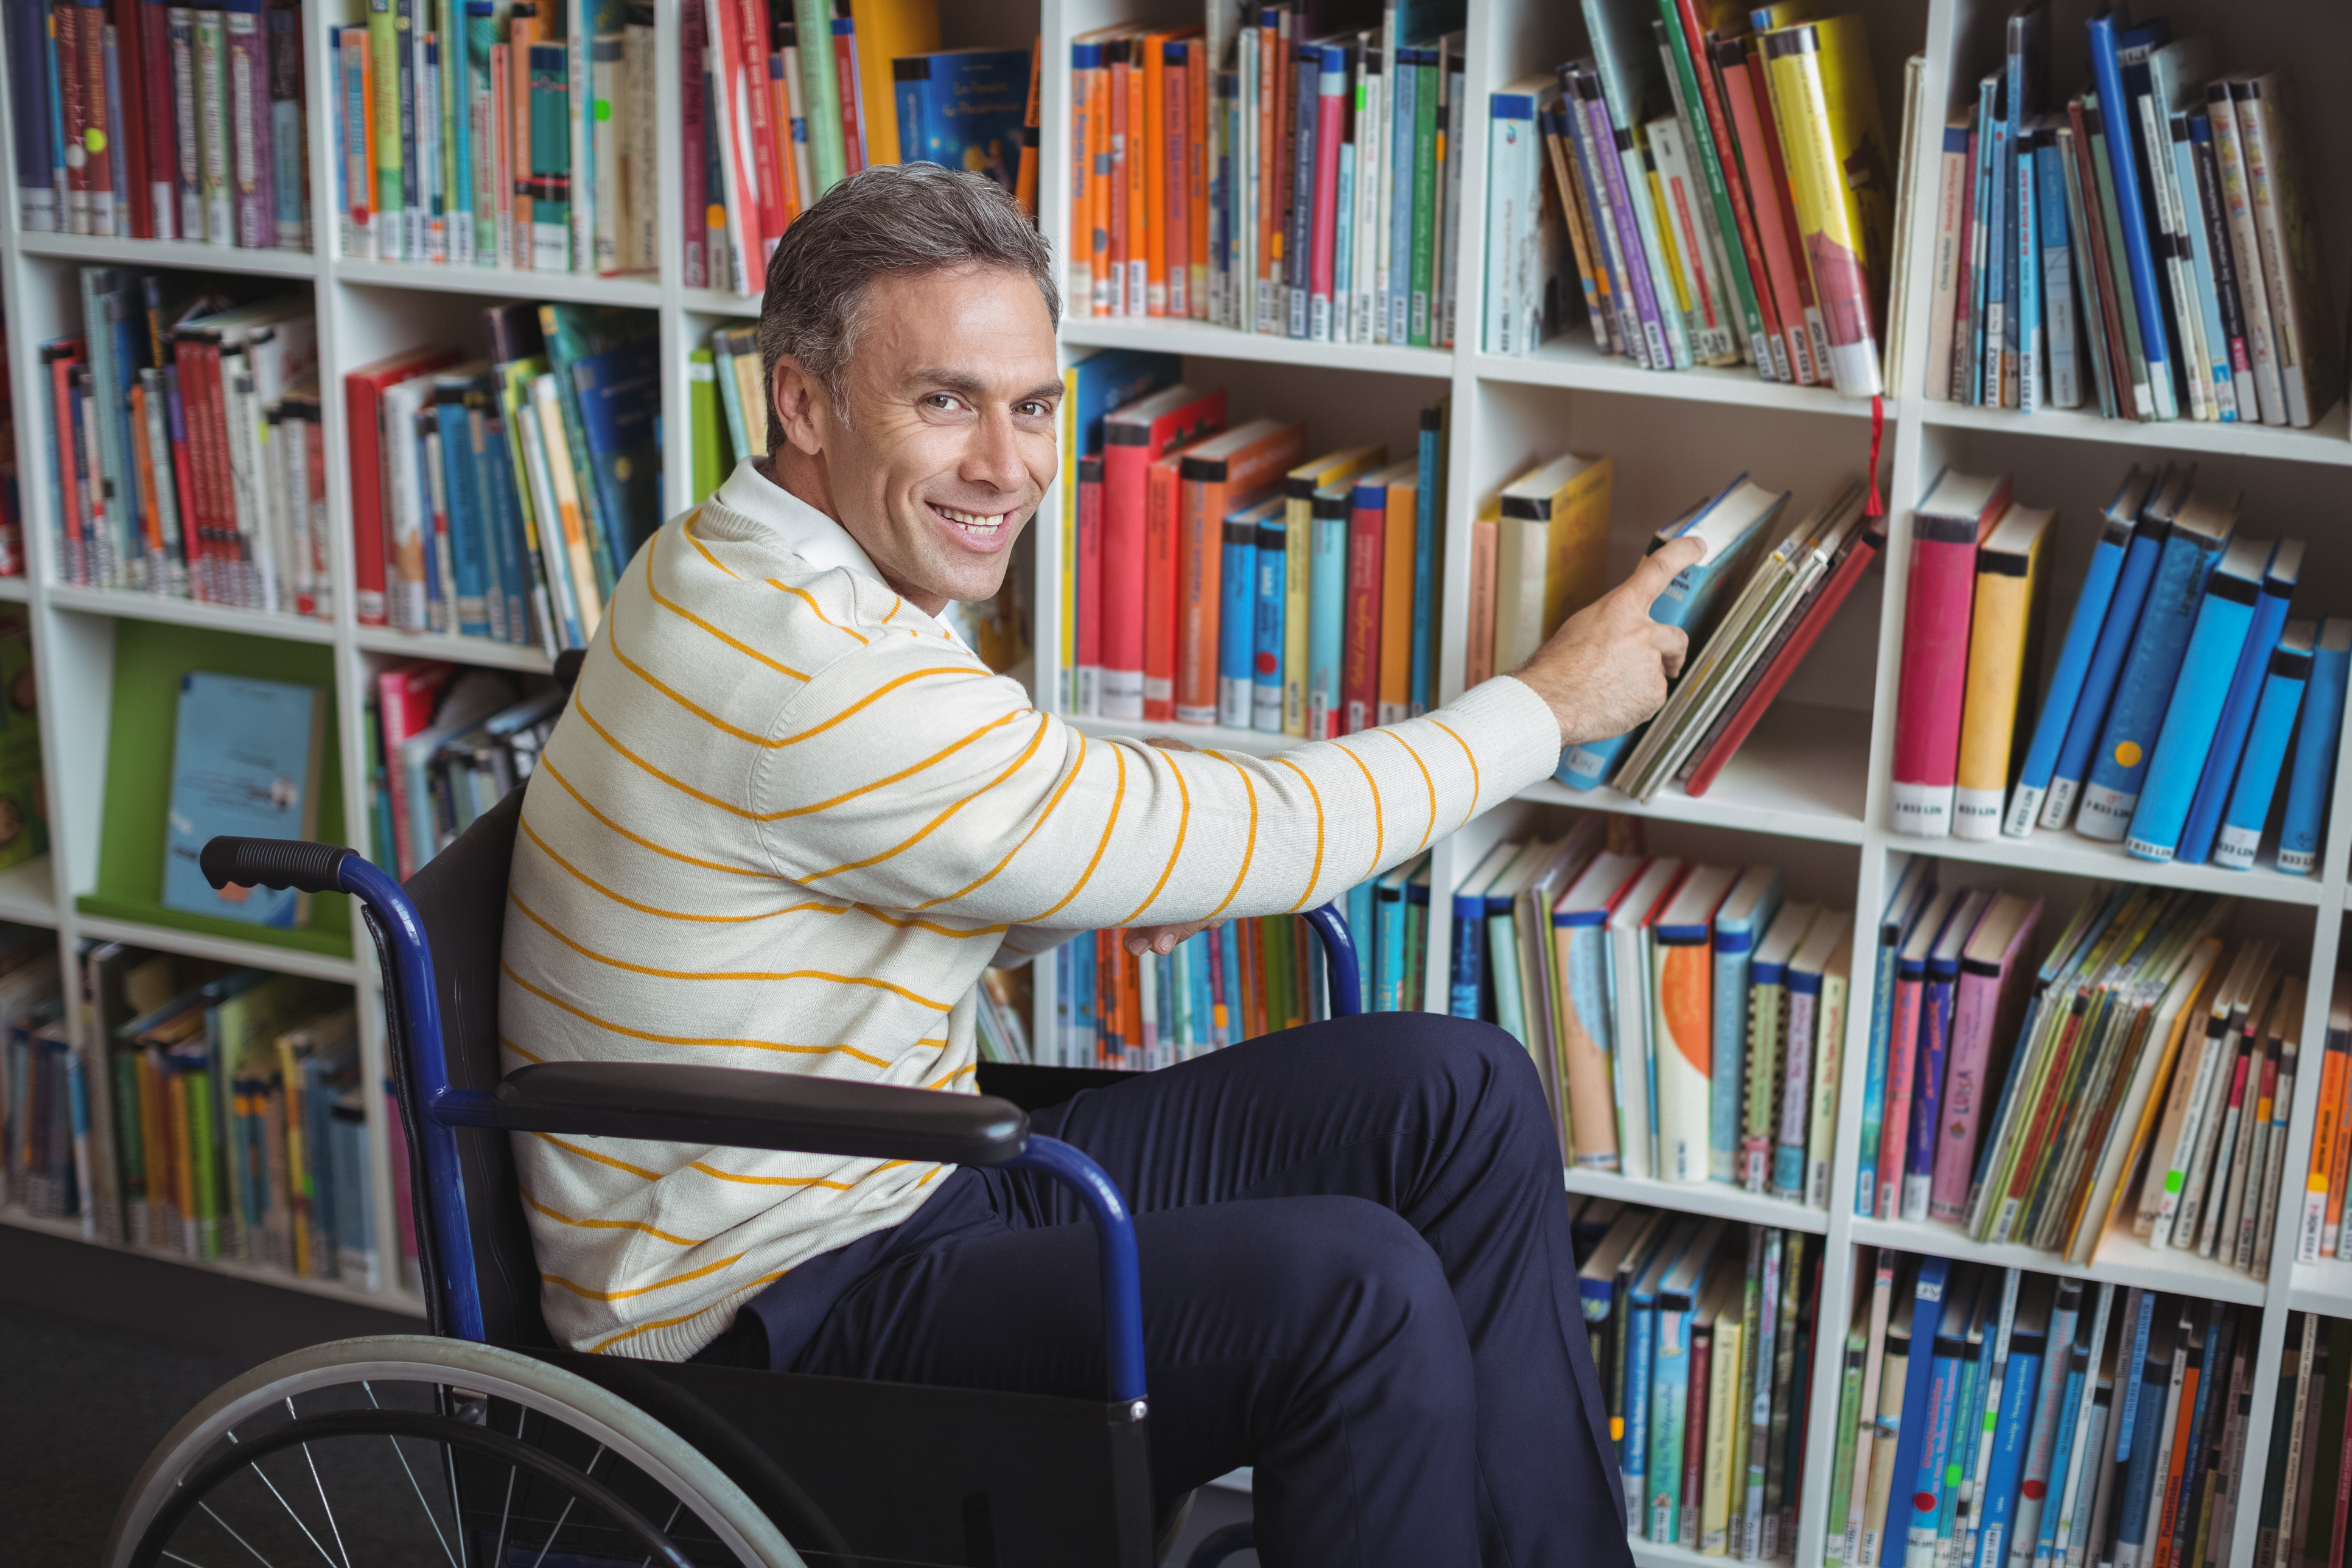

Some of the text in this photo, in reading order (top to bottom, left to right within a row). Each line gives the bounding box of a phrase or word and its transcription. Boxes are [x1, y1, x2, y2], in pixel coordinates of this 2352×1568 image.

[2022, 190, 2029, 203] um
[2022, 245, 2029, 256] An
[1989, 348, 1998, 376] HOLZ
[1987, 379, 1997, 397] 833
[2023, 380, 2031, 400] 833
[1903, 803, 1922, 814] 833
[1923, 806, 1942, 815] LIN
[2017, 808, 2029, 826] 833
[2023, 789, 2035, 808] LIN
[2051, 801, 2063, 819] 833
[2058, 782, 2069, 800] LIN
[2093, 802, 2112, 816] 833
[1958, 804, 1997, 816] 833 LIN
[2133, 841, 2154, 855] 833
[2155, 845, 2174, 858] LIN
[2281, 853, 2302, 866] 833
[2303, 1236, 2314, 1253] 833
